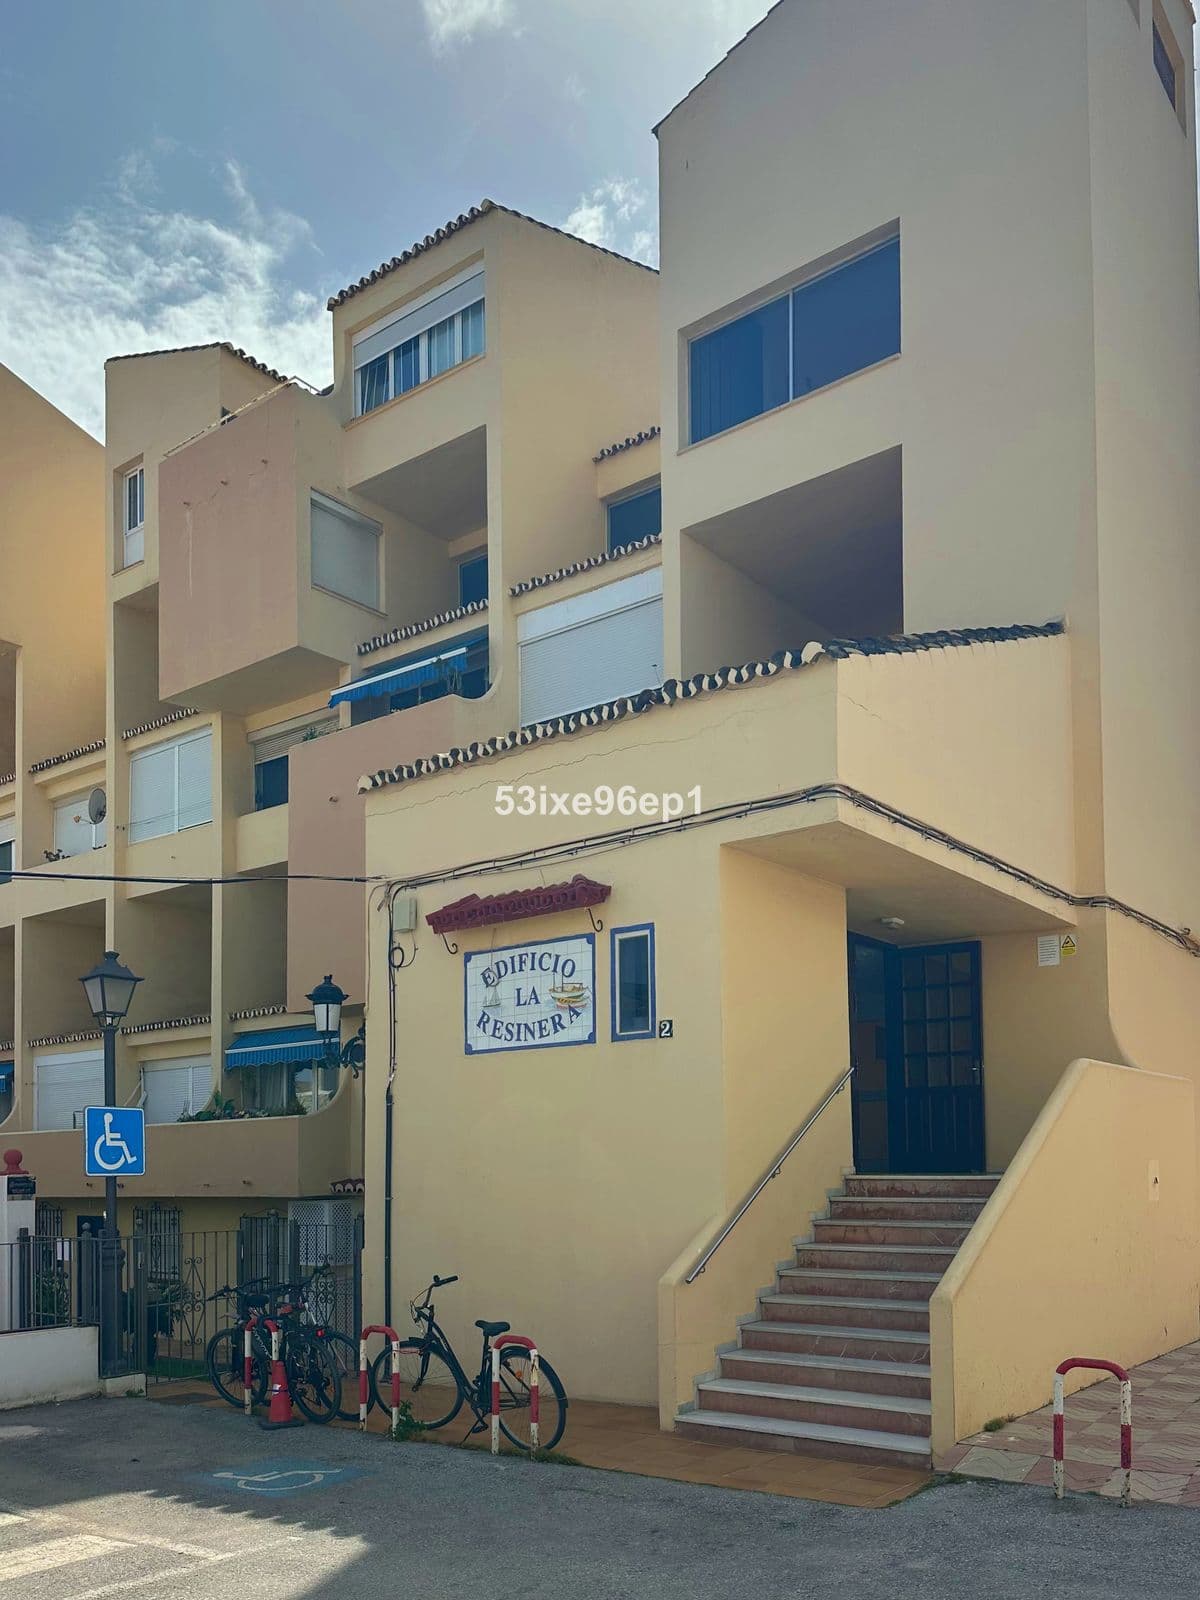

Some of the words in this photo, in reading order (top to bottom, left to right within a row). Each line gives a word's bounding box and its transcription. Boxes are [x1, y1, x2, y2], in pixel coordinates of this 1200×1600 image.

[480, 952, 576, 988] EDIFICIO
[516, 986, 541, 1007] LA
[476, 1004, 582, 1041] RESINERA
[659, 1021, 671, 1037] 2
